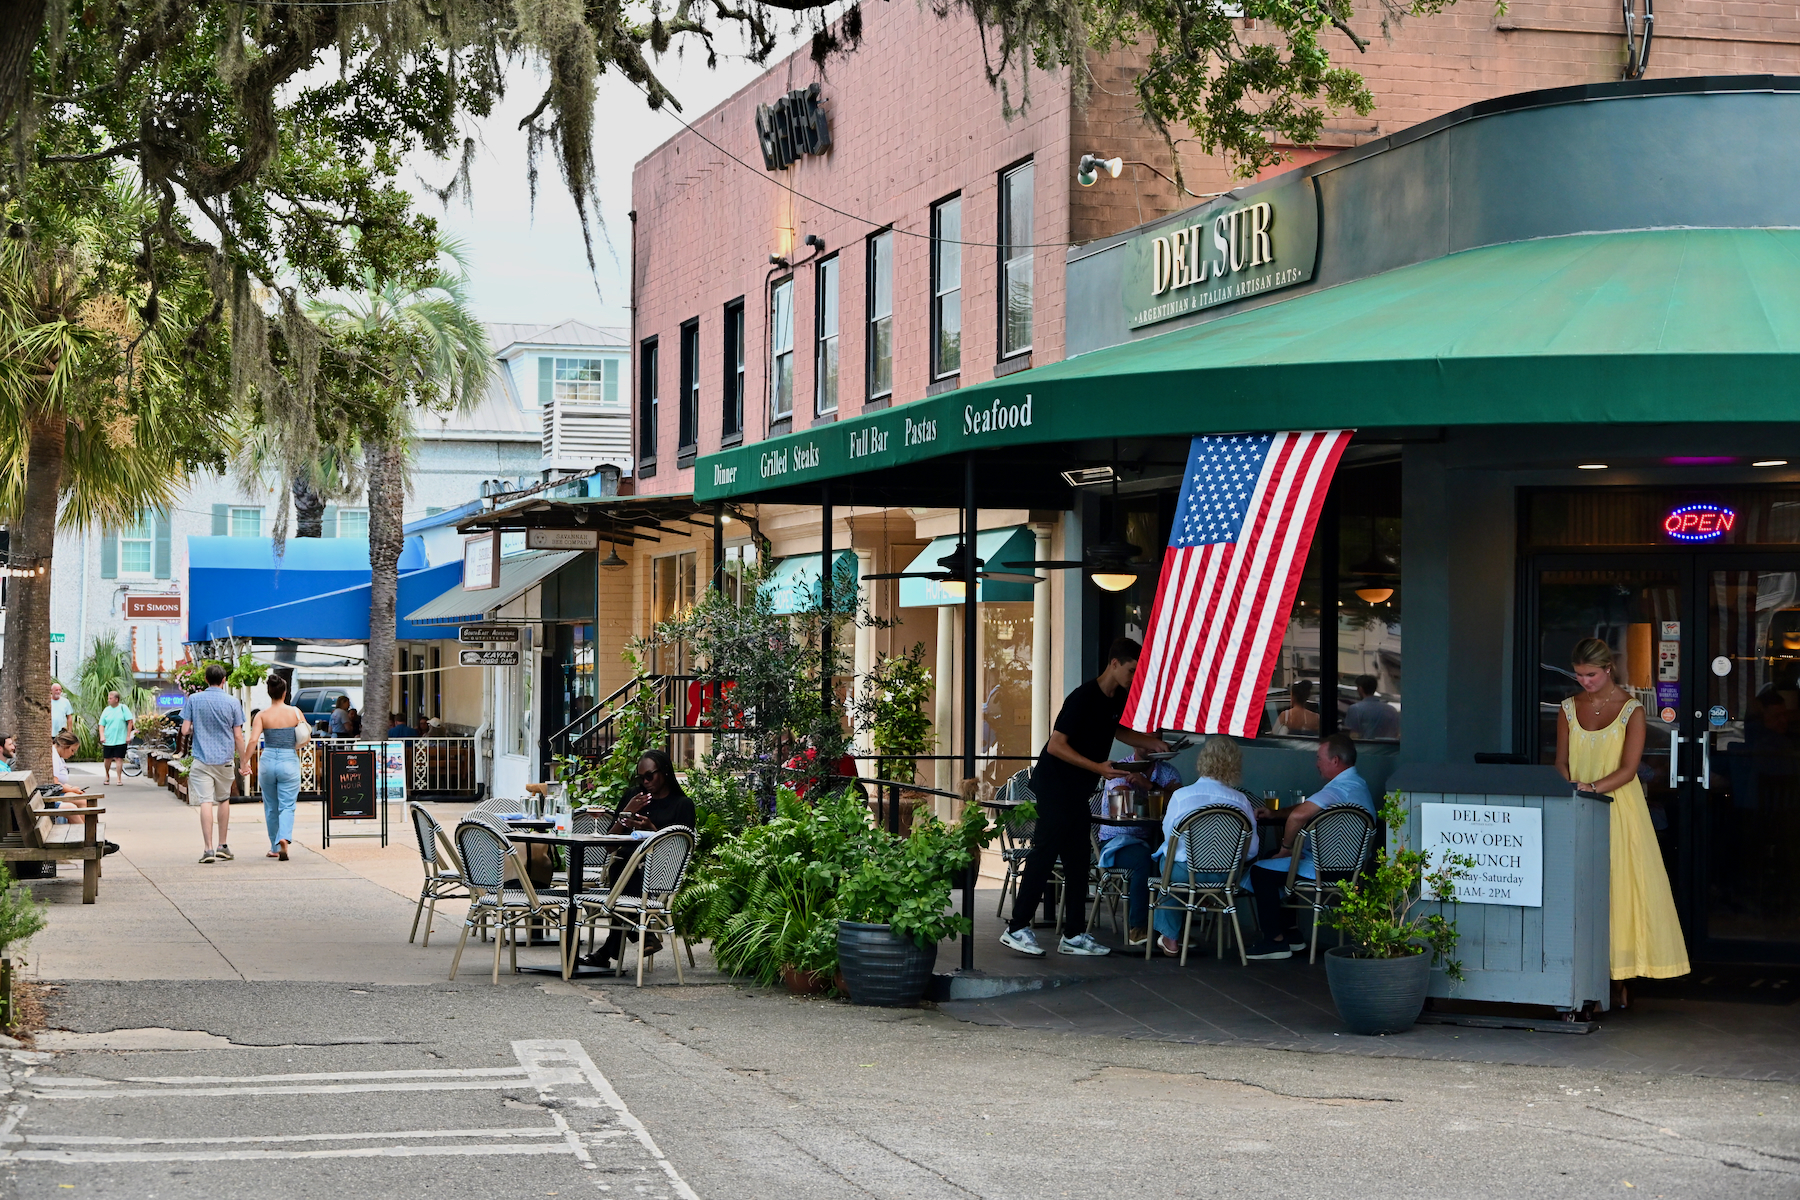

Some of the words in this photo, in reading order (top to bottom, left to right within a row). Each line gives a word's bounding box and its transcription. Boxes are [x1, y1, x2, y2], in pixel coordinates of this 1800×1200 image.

[1151, 223, 1207, 296] DEL
[1212, 201, 1273, 278] SUR
[1138, 296, 1189, 324] ARGENTINIAN
[1191, 296, 1197, 308] &
[1200, 285, 1232, 306] ITALIAN
[1235, 275, 1272, 296] ARTISAN
[1275, 268, 1297, 286] EATS
[713, 463, 737, 486] Dinner
[760, 448, 787, 478] Grilled
[793, 442, 819, 472] Steaks
[849, 429, 868, 459] Full
[870, 427, 888, 455] Bar
[905, 416, 937, 447] Pastas
[963, 394, 1033, 436] Seafood
[1664, 513, 1735, 532] OPEN
[133, 603, 145, 611] ST
[146, 603, 179, 612] SIMONS
[51, 634, 65, 642] Ave
[339, 773, 362, 783] HAPPY
[1453, 809, 1481, 823] DEL
[1484, 811, 1511, 824] SUR
[1440, 831, 1478, 846] NOW
[1482, 833, 1523, 847] OPEN
[1441, 871, 1524, 887] uesday-Saturday
[1488, 887, 1511, 899] 2PM
